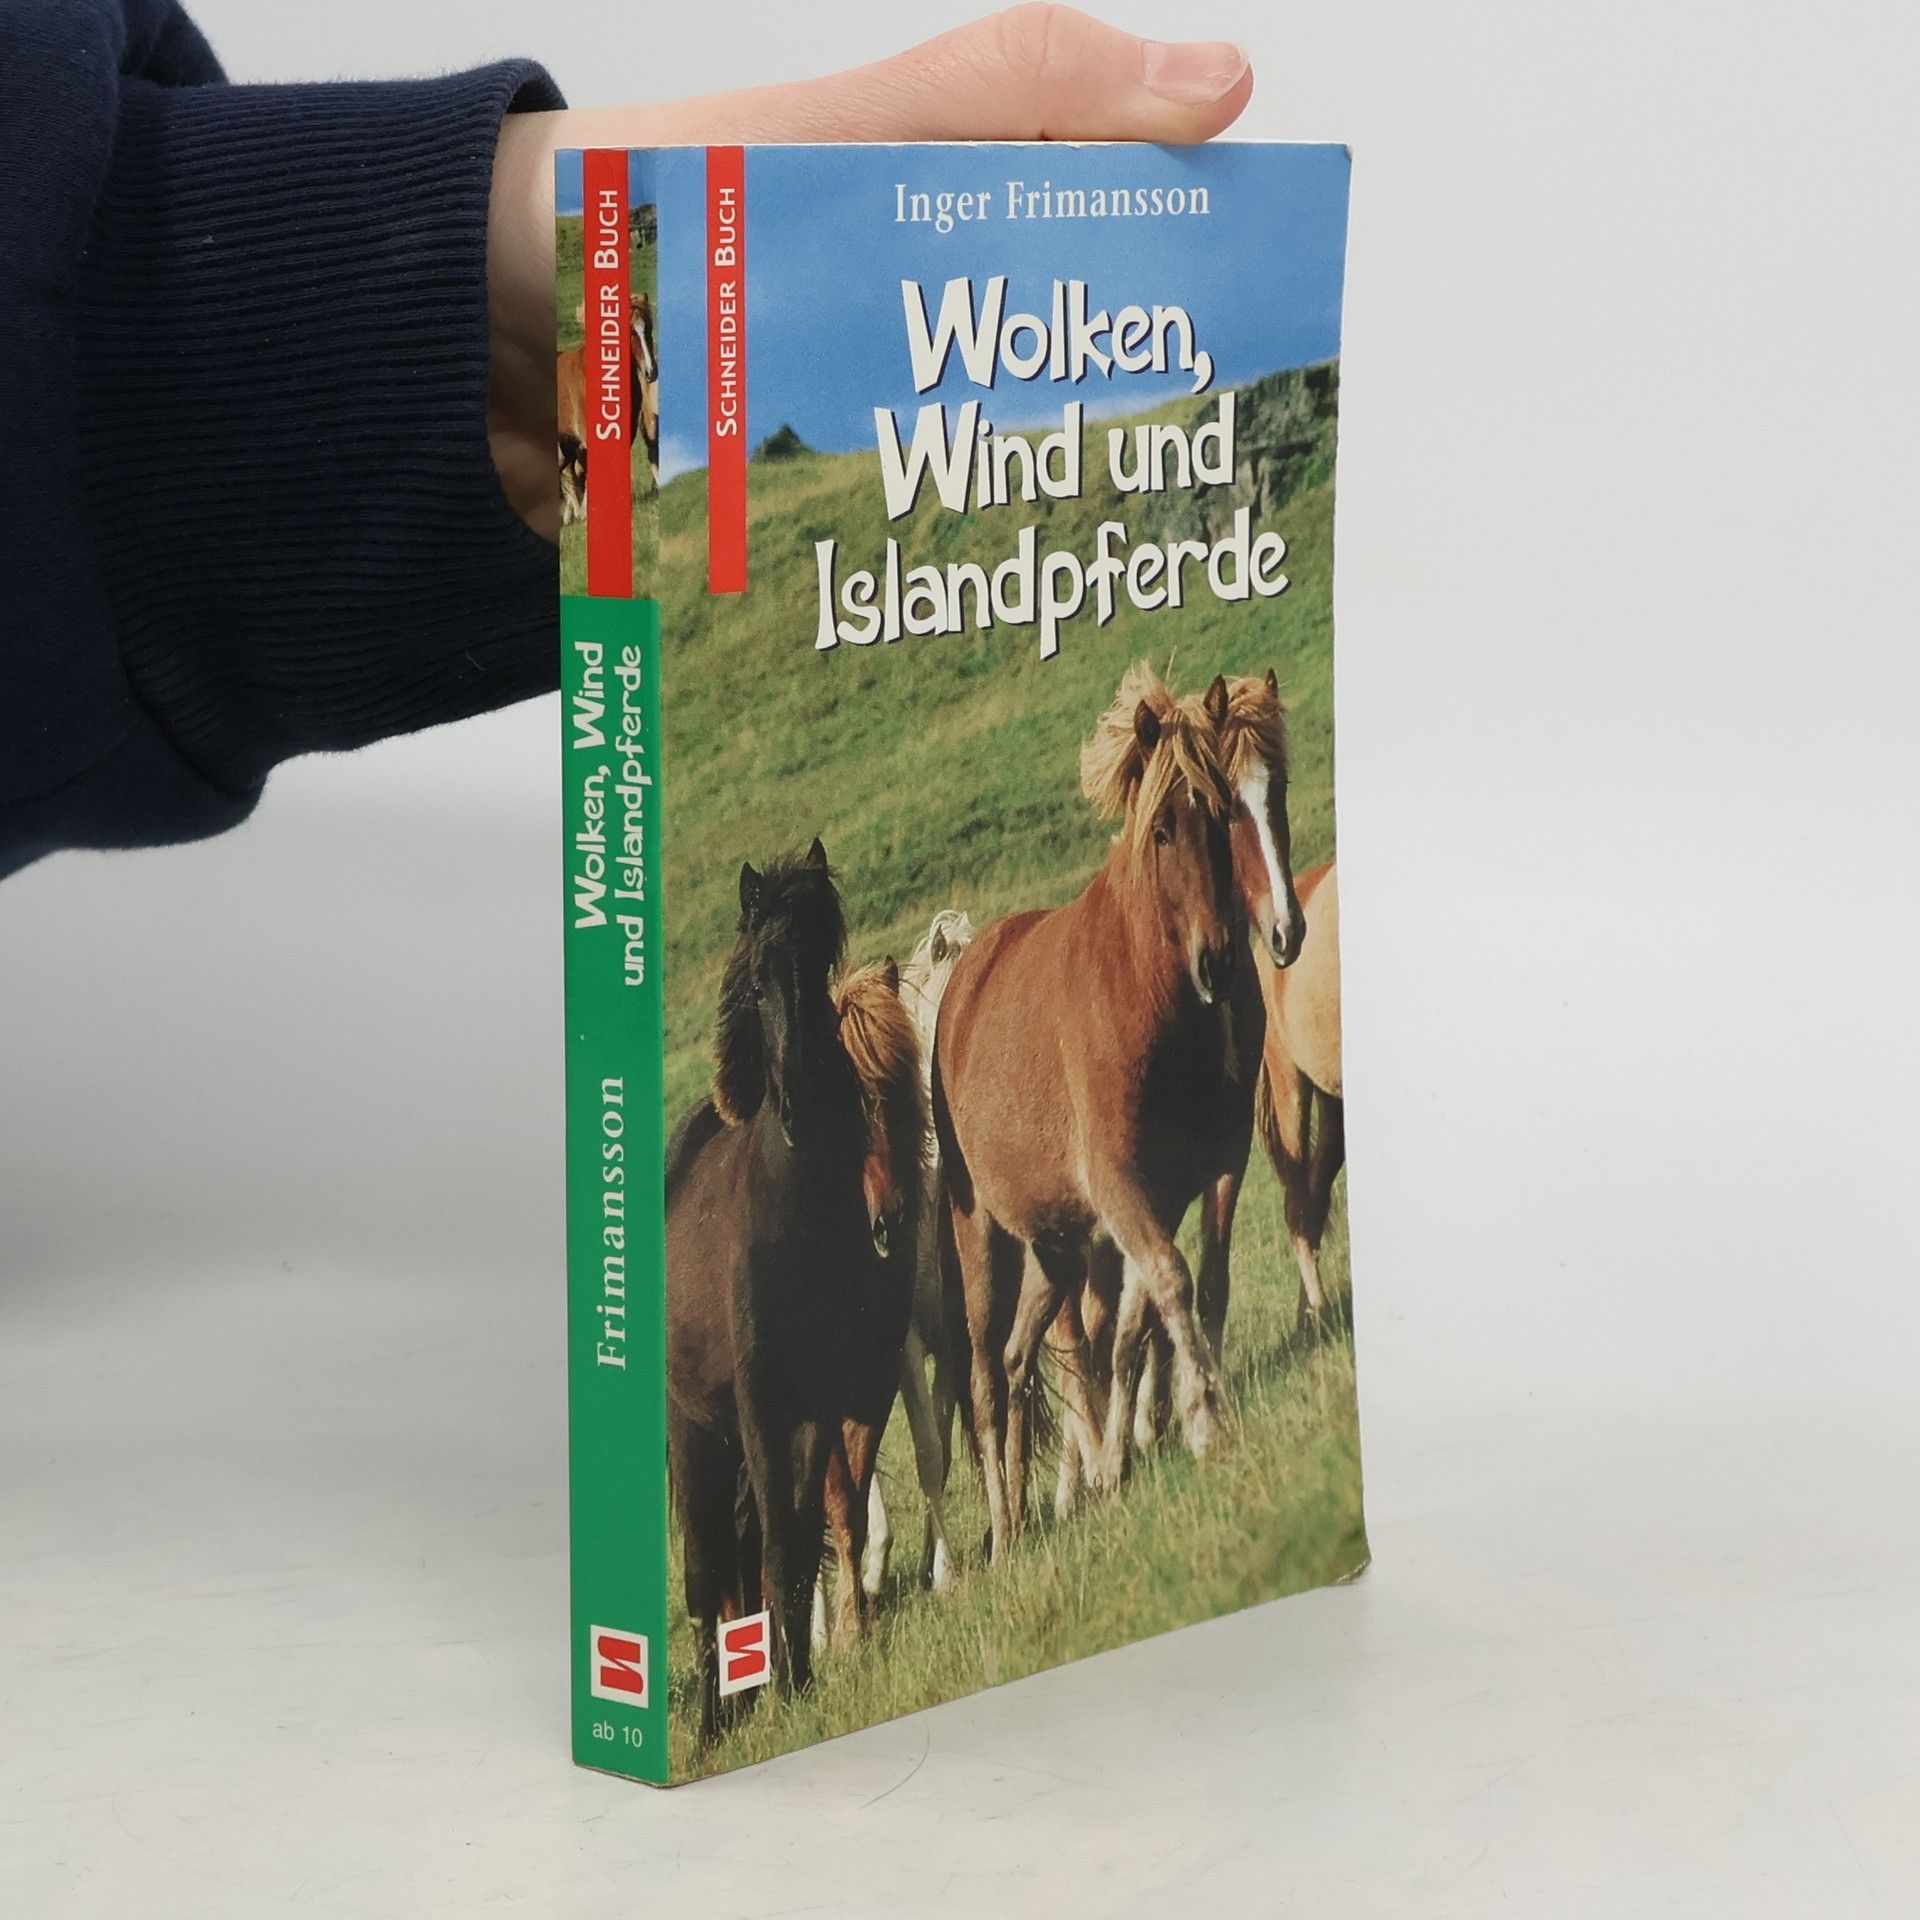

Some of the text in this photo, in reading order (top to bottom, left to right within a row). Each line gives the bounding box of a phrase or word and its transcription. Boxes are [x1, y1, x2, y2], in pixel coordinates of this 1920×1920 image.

[894, 180, 1211, 234] Inger Frimansson
[594, 190, 621, 440] SCHNEIDER BUCH
[715, 188, 737, 436] SCHNEIDER BUCH
[901, 275, 1214, 394] Wolken,
[874, 392, 1237, 522] Wind und
[813, 507, 1291, 660] Islandpferde
[573, 641, 612, 929] Wolken, Wind
[614, 645, 652, 986] und Islandpferde
[597, 1076, 626, 1370] Frimansson
[592, 1720, 643, 1748] ab 10
